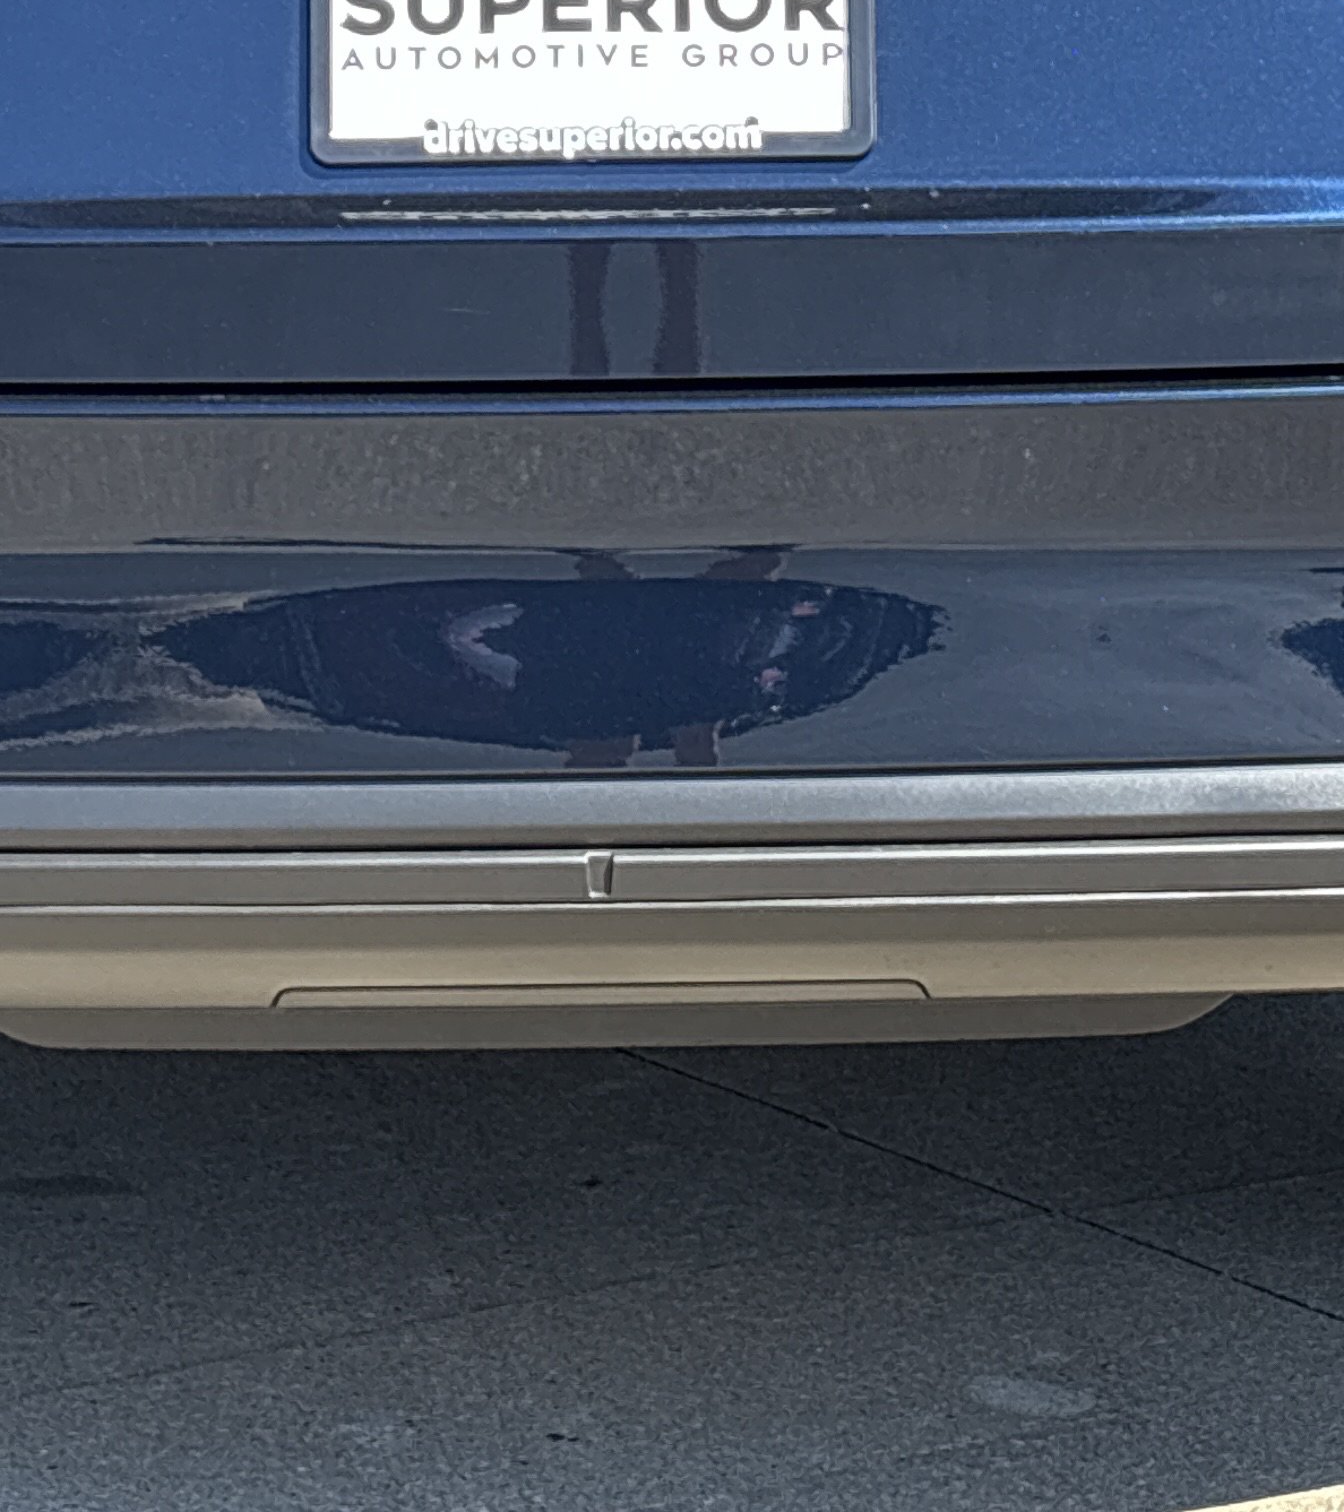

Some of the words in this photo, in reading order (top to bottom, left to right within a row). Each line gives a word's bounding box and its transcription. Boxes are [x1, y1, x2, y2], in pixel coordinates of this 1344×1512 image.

[341, 44, 650, 72] AUTOMOTIVE
[681, 42, 844, 67] GROUP
[422, 117, 764, 161] drivesuperior.com
